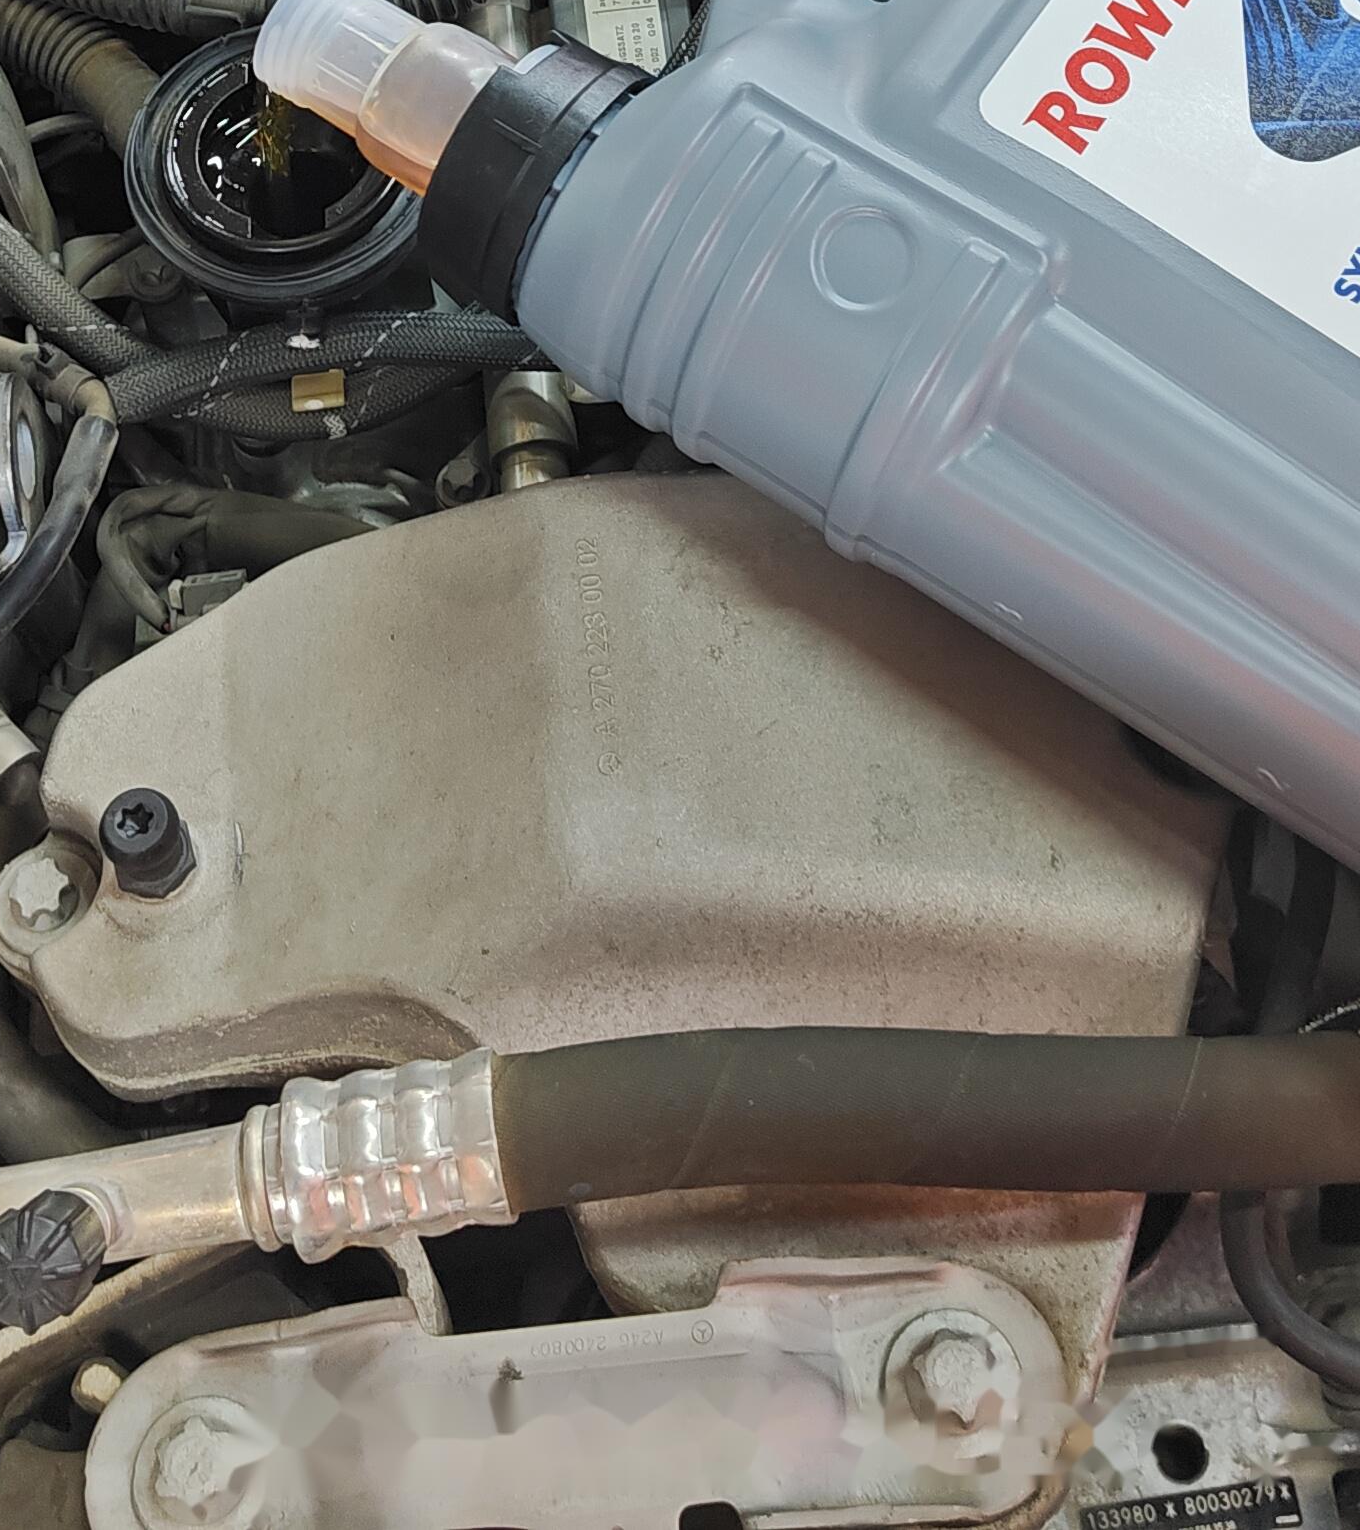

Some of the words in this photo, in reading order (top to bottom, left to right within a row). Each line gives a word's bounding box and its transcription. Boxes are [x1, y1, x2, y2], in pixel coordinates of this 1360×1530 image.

[614, 24, 627, 61] GSSATZ
[573, 533, 602, 568] 02
[577, 572, 604, 604] 00
[581, 610, 610, 656] 223
[586, 661, 615, 712] 270
